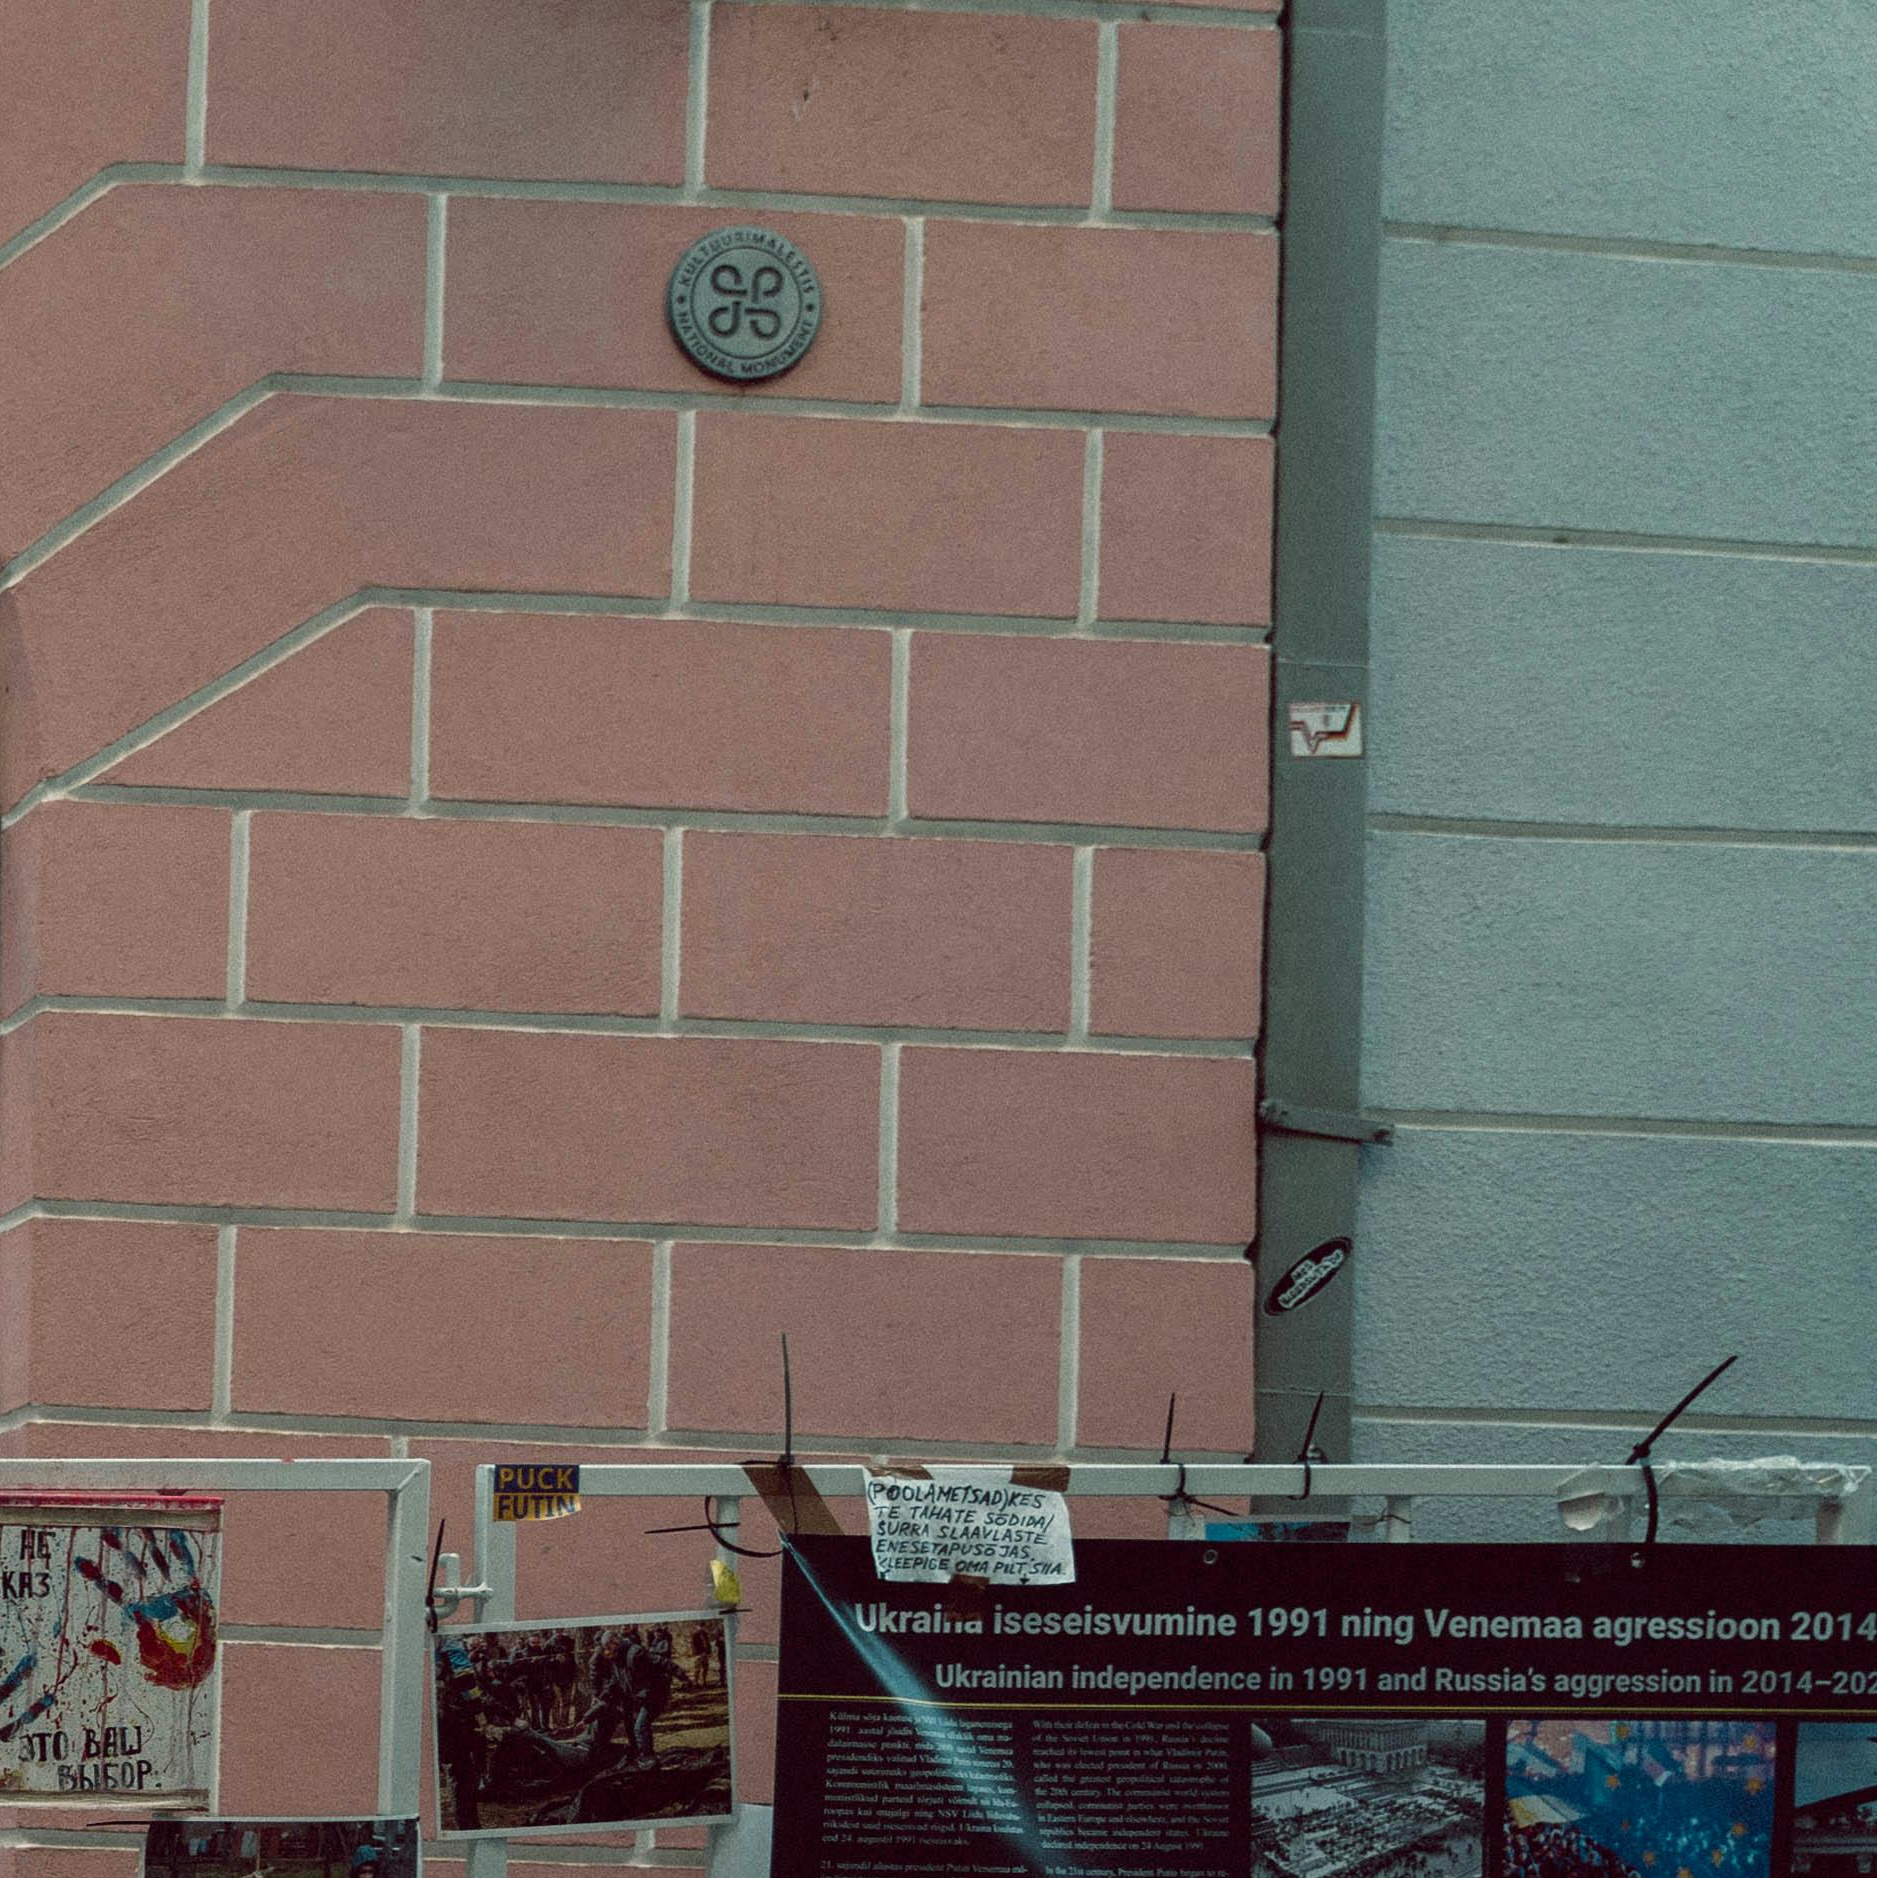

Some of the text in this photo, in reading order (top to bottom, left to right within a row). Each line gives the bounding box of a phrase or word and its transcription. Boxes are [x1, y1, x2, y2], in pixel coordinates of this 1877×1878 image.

[500, 1467, 573, 1489] PUCK
[498, 1496, 575, 1520] FUTIN
[874, 1506, 900, 1519] TE
[910, 1506, 976, 1524] TAHATE
[20, 1529, 56, 1561] НЕ
[939, 1525, 1047, 1544] SLAAVLASTE
[955, 1560, 988, 1572] OMA
[994, 1605, 1238, 1638] iseseisvumine
[1248, 1607, 1328, 1638] 1991
[1341, 1607, 1415, 1645] ning
[1425, 1609, 1583, 1640] Venemaa
[1593, 1610, 1781, 1647] agressioon
[935, 1663, 1064, 1690] Ukrainian
[1072, 1664, 1261, 1696] independence
[1269, 1666, 1294, 1691] in
[1303, 1668, 1368, 1691] 1991
[1378, 1667, 1427, 1692] and
[1554, 1669, 1702, 1699] aggression
[1709, 1669, 1733, 1695] in
[18, 1725, 143, 1762] ЭТО ВАШ
